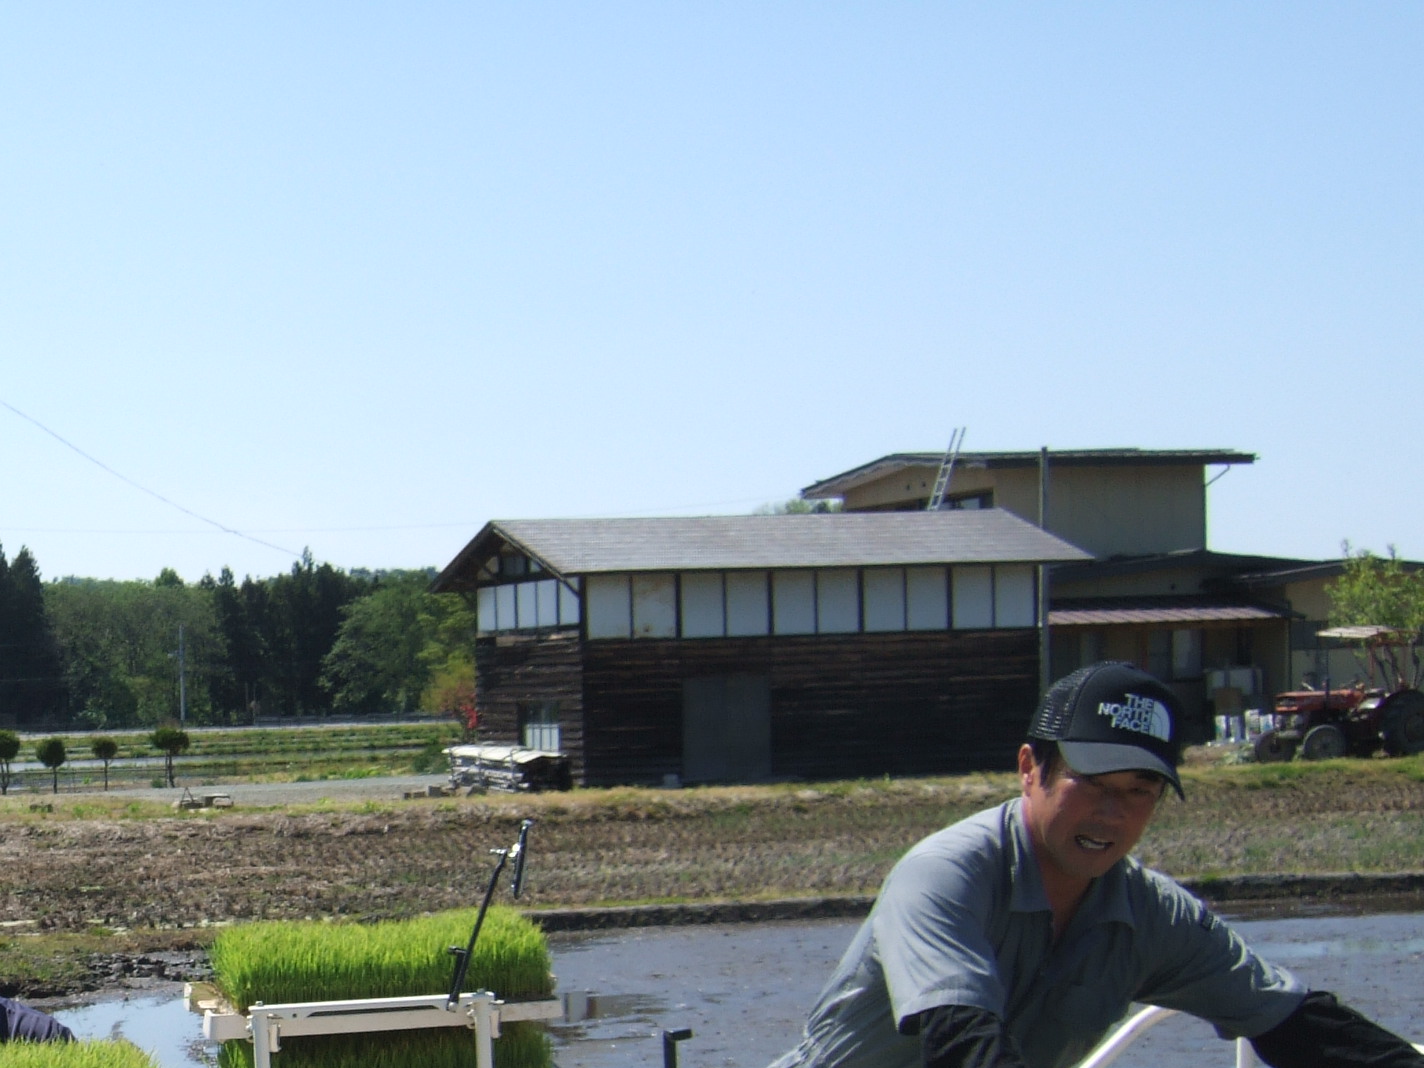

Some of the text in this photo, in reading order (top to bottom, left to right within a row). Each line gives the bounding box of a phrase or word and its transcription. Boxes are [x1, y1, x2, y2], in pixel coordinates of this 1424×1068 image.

[1124, 693, 1153, 710] THE
[1098, 702, 1151, 722] NORTH
[1111, 714, 1150, 734] FACE
